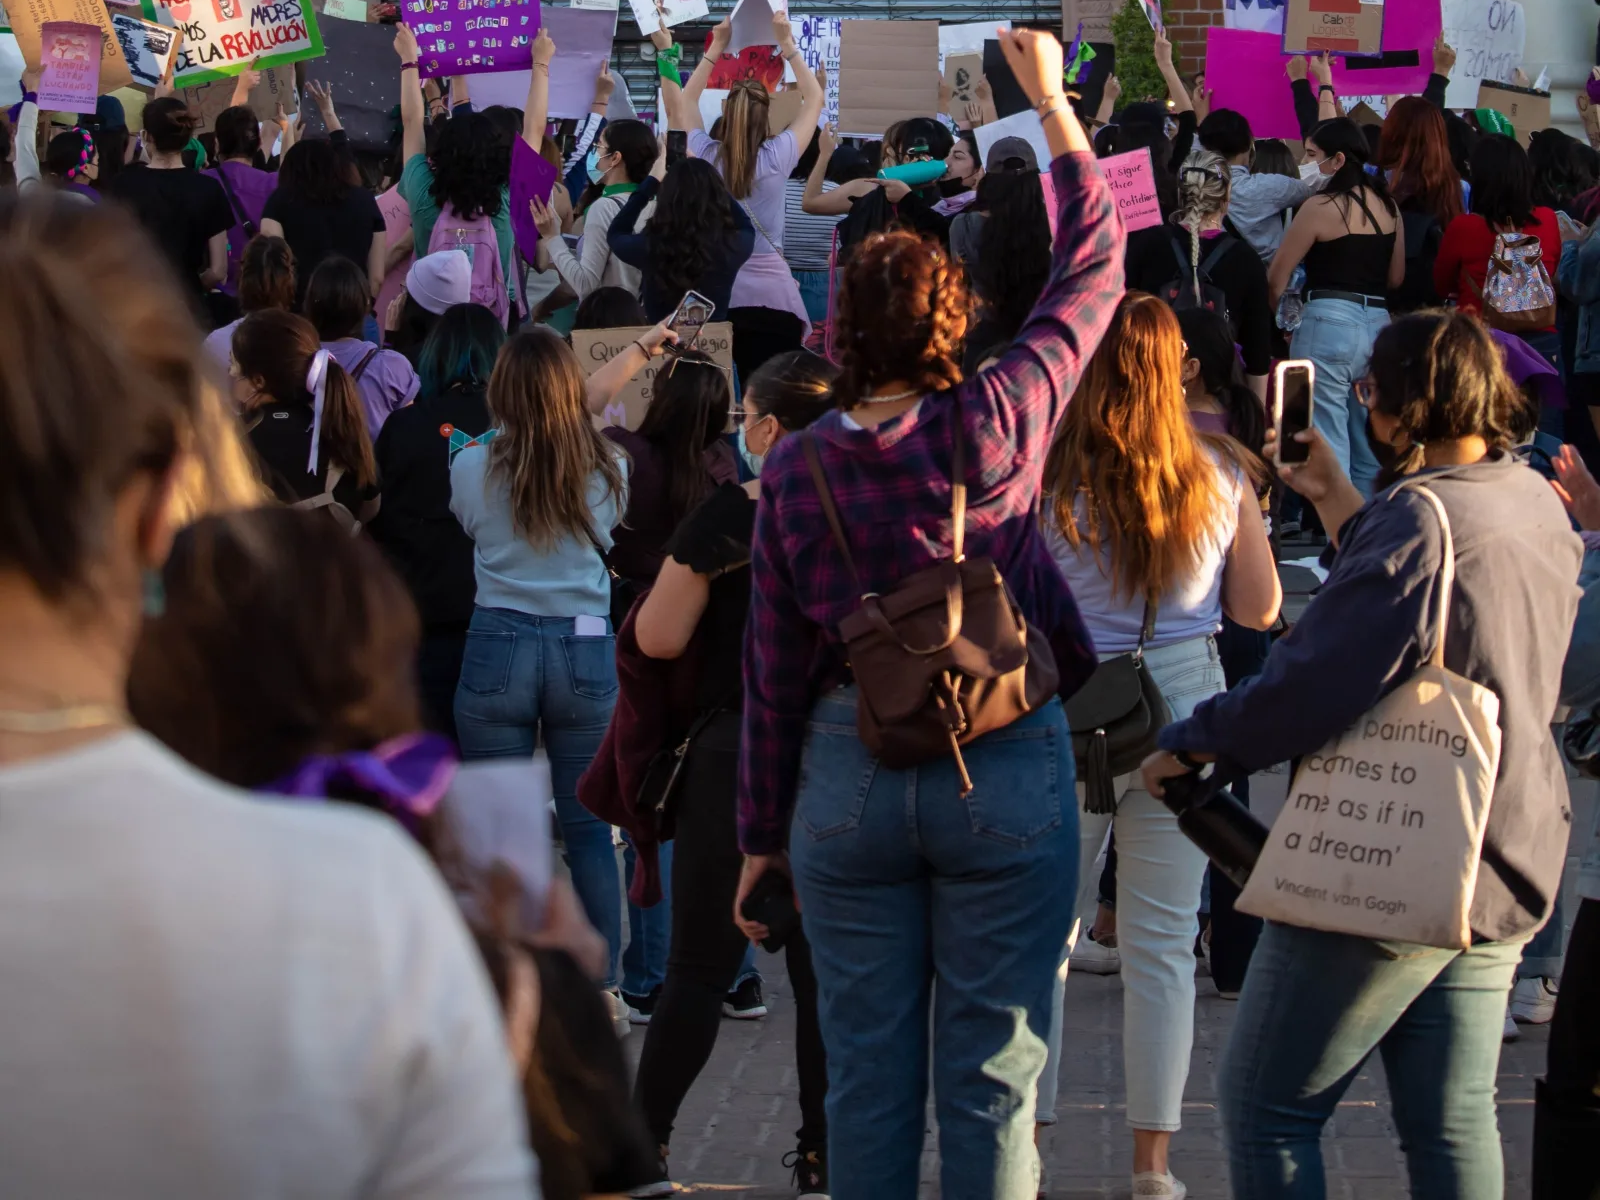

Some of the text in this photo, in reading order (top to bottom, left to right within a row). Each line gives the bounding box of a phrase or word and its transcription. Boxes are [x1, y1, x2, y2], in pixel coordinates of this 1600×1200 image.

[174, 21, 206, 42] MOS
[1322, 13, 1344, 26] Cab
[176, 18, 309, 72] DE LA REVOLUCIÓN
[44, 80, 93, 91] LUCHANDO
[266, 66, 279, 95] UIDADO
[1118, 164, 1142, 178] sigue
[1362, 717, 1469, 758] painting
[1308, 754, 1416, 784] comes to
[1338, 799, 1368, 821] as
[1376, 799, 1395, 826] if
[1401, 807, 1424, 829] in
[1284, 832, 1301, 850] a
[1274, 876, 1407, 915] Vincent van Gogh
